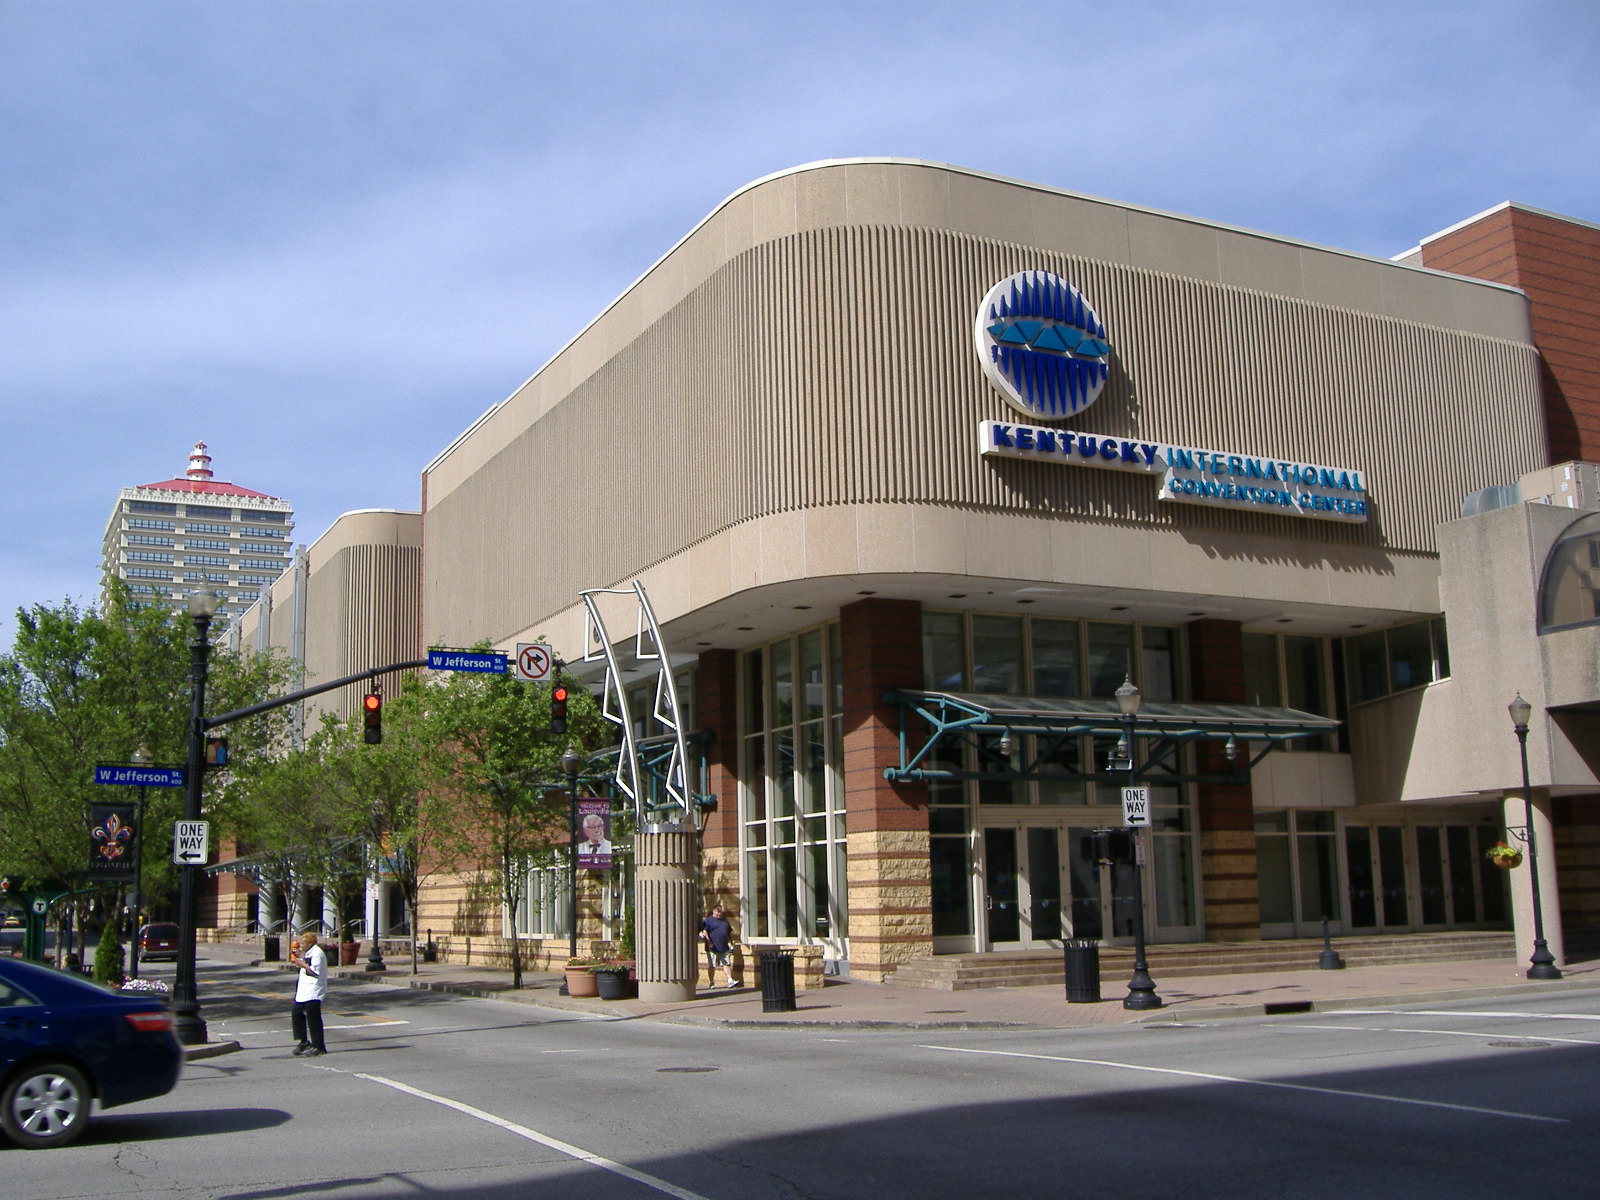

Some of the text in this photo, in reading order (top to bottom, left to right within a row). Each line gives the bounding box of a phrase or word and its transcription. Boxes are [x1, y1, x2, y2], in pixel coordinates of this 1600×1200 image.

[993, 424, 1366, 492] KENTUCKY INTERNATIONAL
[1168, 477, 1367, 516] CONVENTION CENTER
[432, 656, 443, 666] W
[444, 657, 491, 668] Jefferson
[100, 770, 111, 780] W
[114, 770, 168, 783] Jefferson
[1126, 789, 1145, 802] ONE
[1126, 801, 1145, 813] WAY
[180, 823, 204, 837] ONE
[179, 837, 204, 849] WAY
